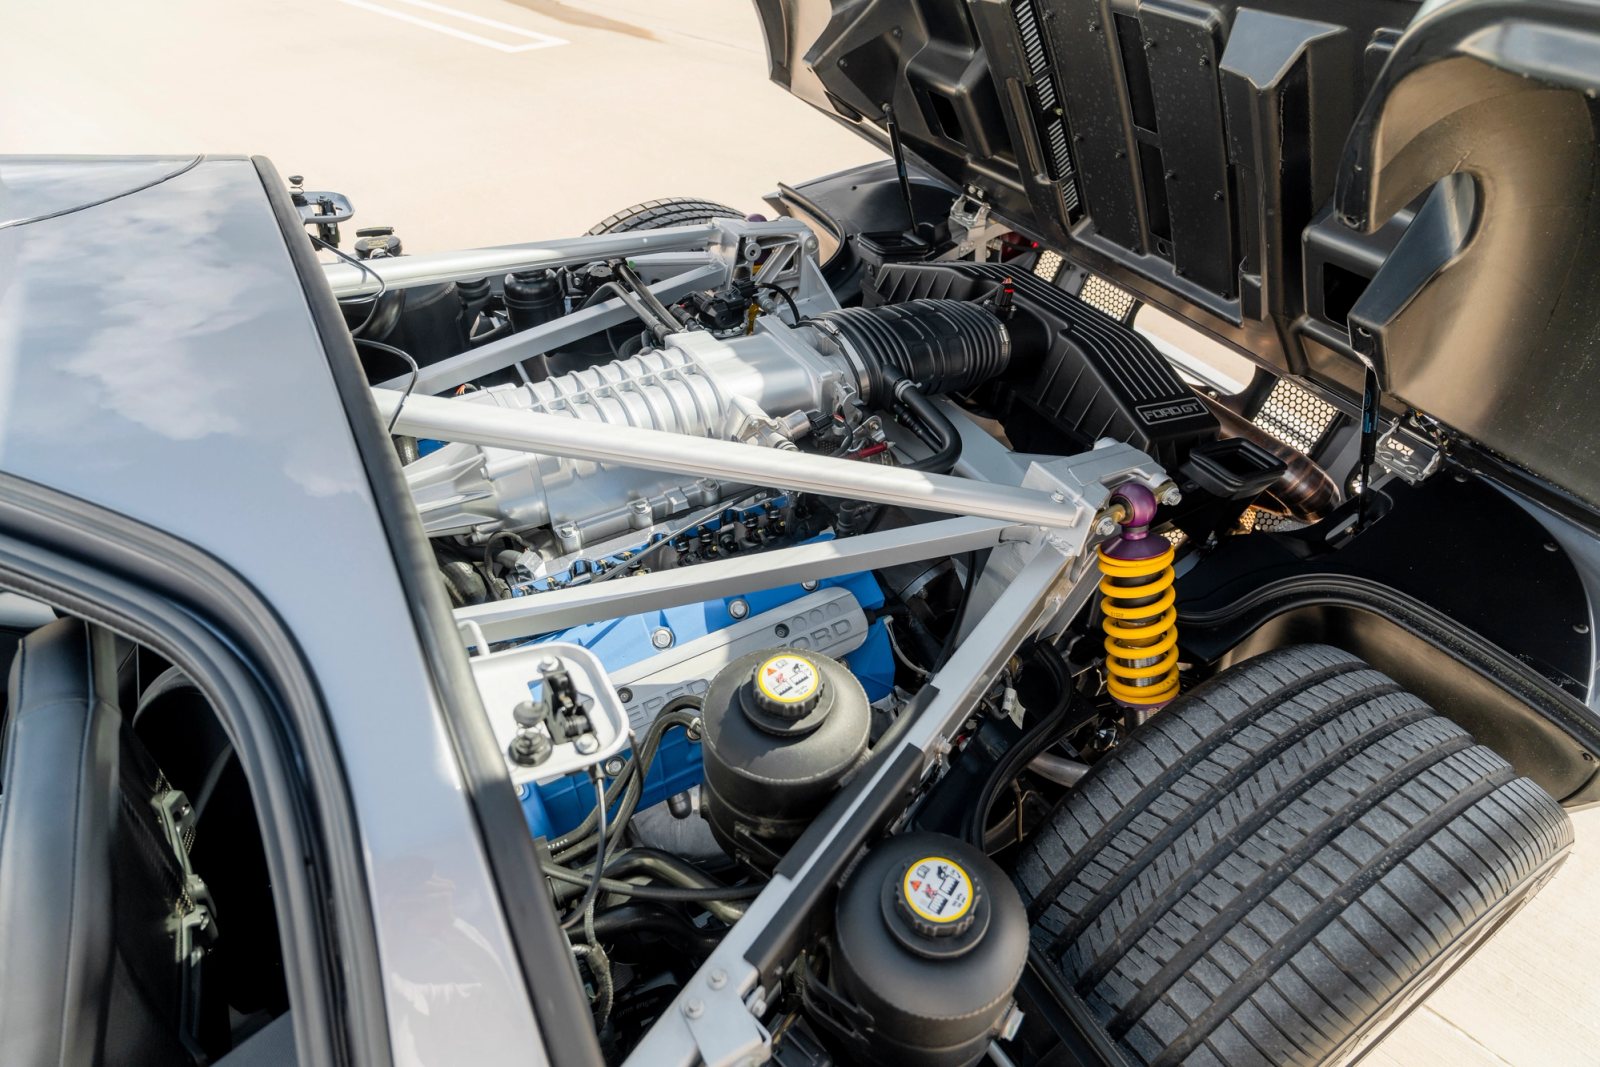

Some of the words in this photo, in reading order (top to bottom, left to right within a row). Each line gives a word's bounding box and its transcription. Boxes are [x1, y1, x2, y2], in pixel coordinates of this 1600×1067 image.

[1142, 406, 1182, 420] FORD
[1181, 402, 1199, 413] GT
[777, 619, 852, 649] ORD
